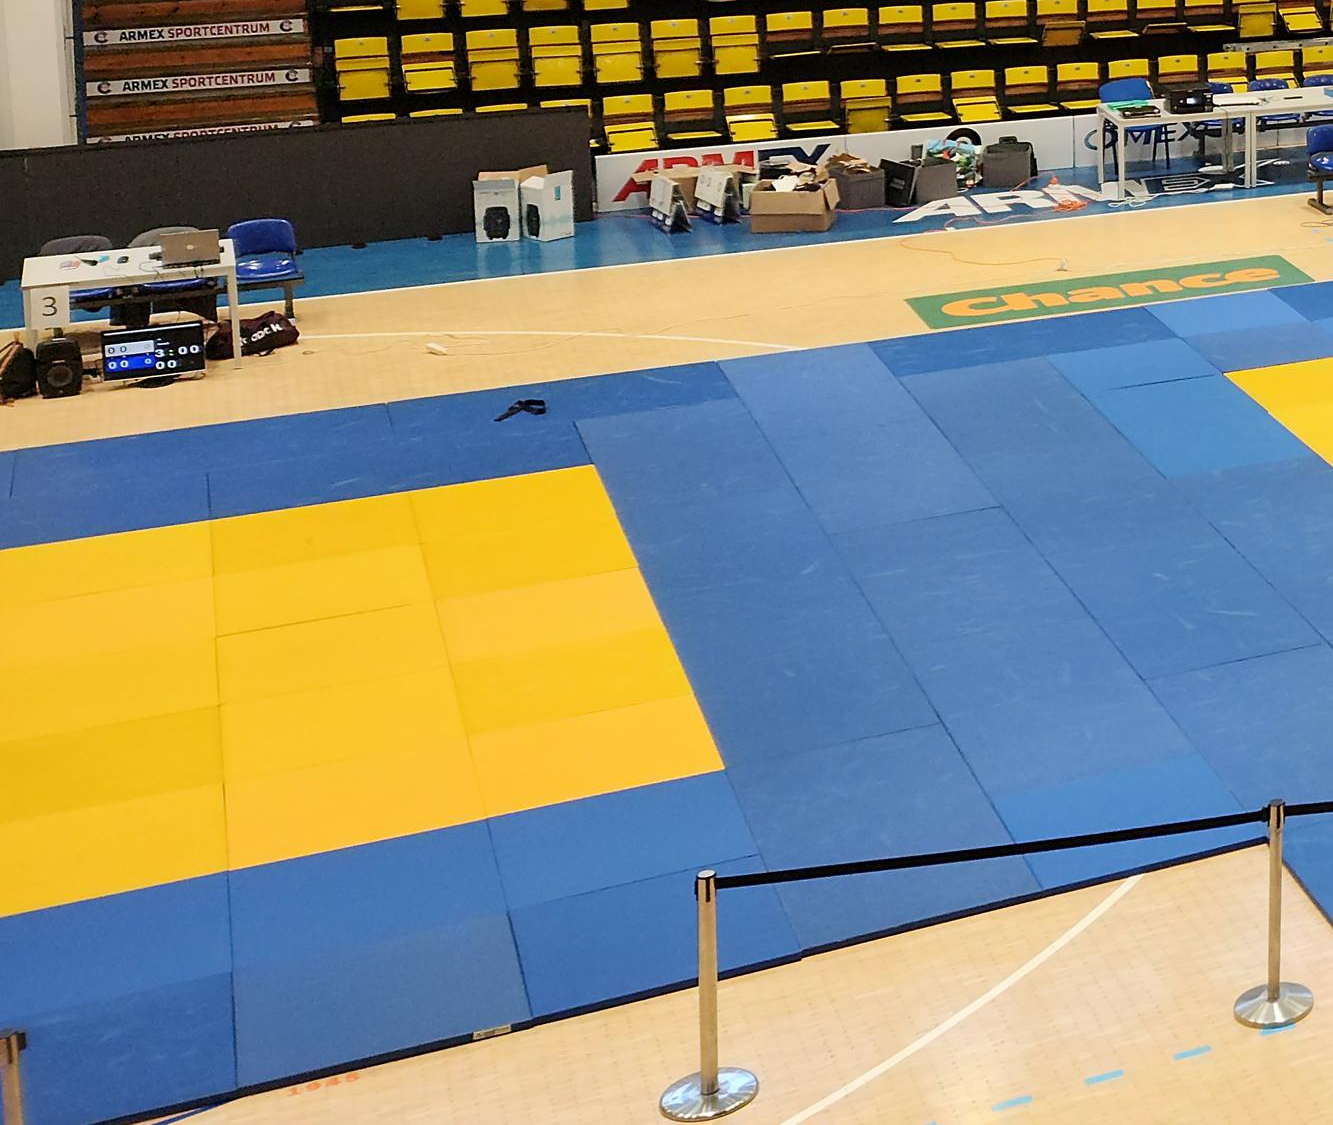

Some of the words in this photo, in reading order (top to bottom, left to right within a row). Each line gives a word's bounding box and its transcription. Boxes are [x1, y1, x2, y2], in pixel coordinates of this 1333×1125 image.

[119, 29, 164, 42] ARMEX
[168, 23, 270, 39] SPORTCENTRUM
[122, 79, 168, 92] ARMEX
[172, 73, 275, 89] SPORTCENTRUM
[941, 266, 1280, 318] Chance
[41, 296, 58, 317] 3
